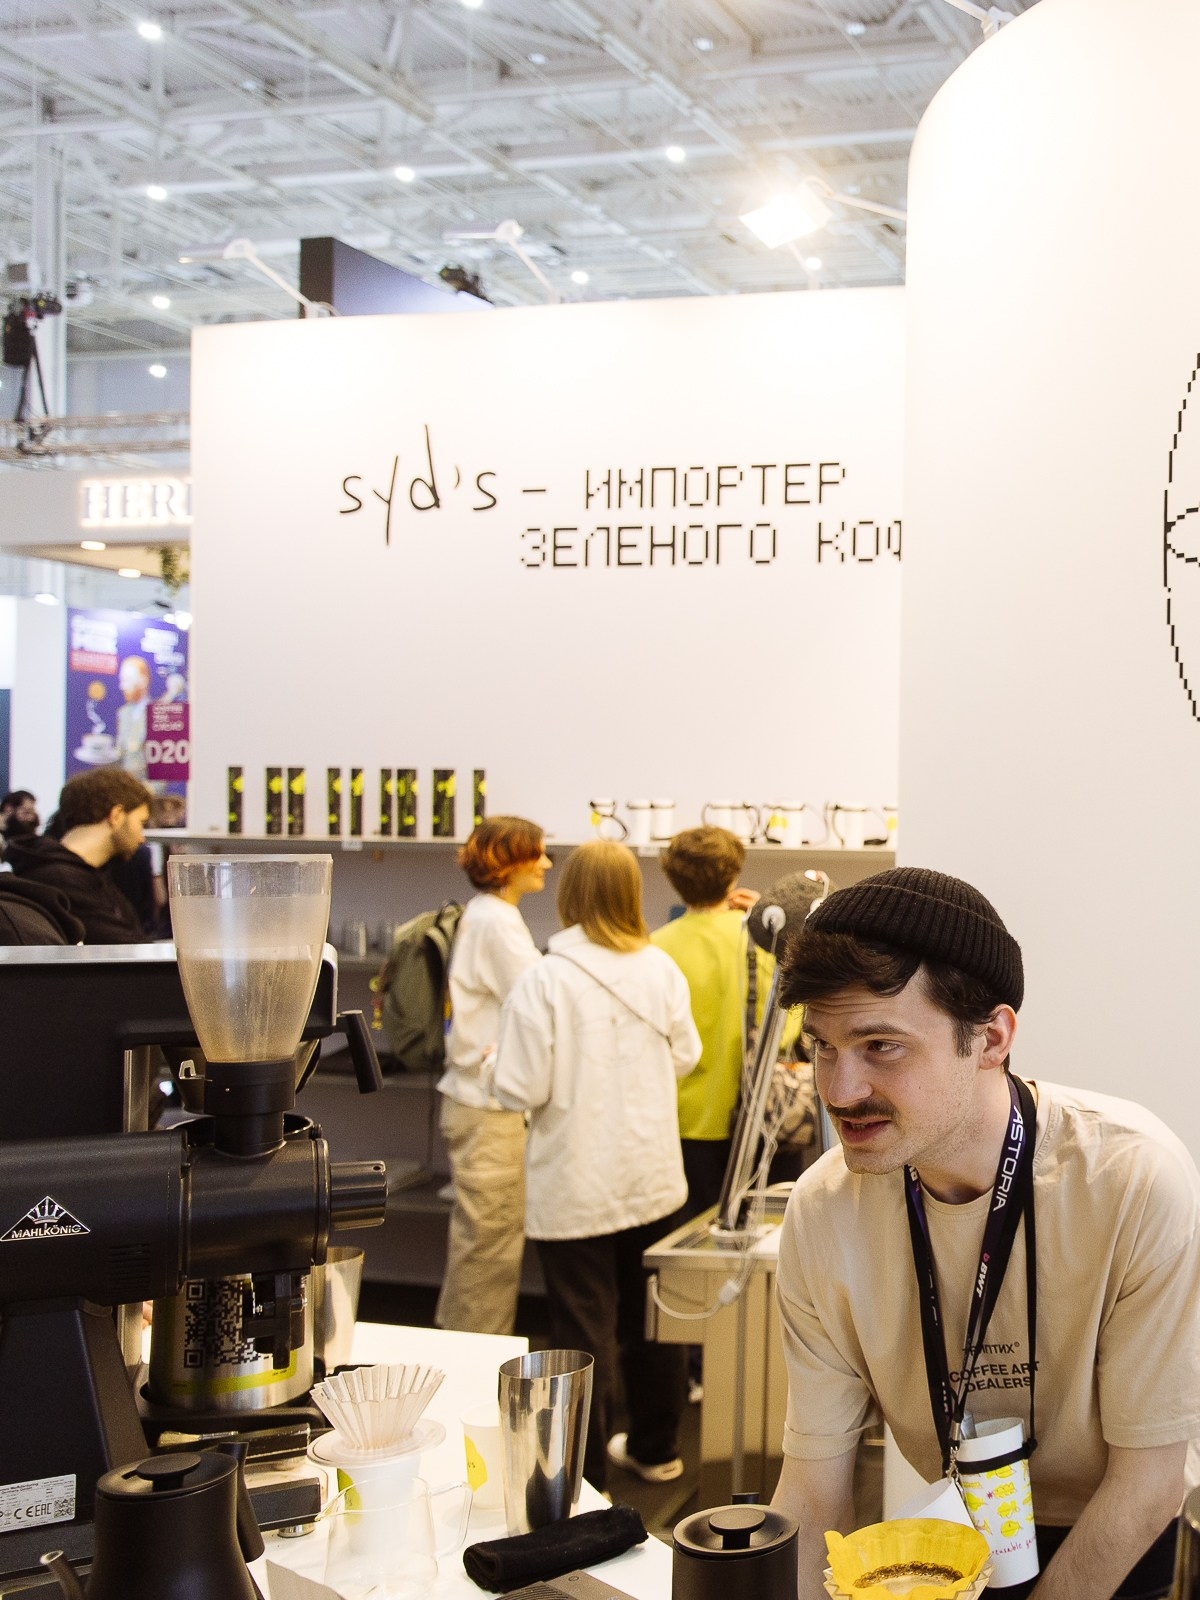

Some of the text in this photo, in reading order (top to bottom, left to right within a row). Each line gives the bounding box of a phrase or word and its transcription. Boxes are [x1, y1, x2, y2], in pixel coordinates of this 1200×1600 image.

[339, 424, 498, 547] syd's
[586, 462, 846, 510] ИМПОРТЕР
[521, 522, 776, 568] ЗЕЛЕНОГО
[147, 739, 190, 764] D20
[993, 1104, 1024, 1212] ASTORIA
[976, 1260, 989, 1298] BWT
[949, 1360, 1040, 1383] COFFEE ART
[964, 1376, 1031, 1393] DEALERS
